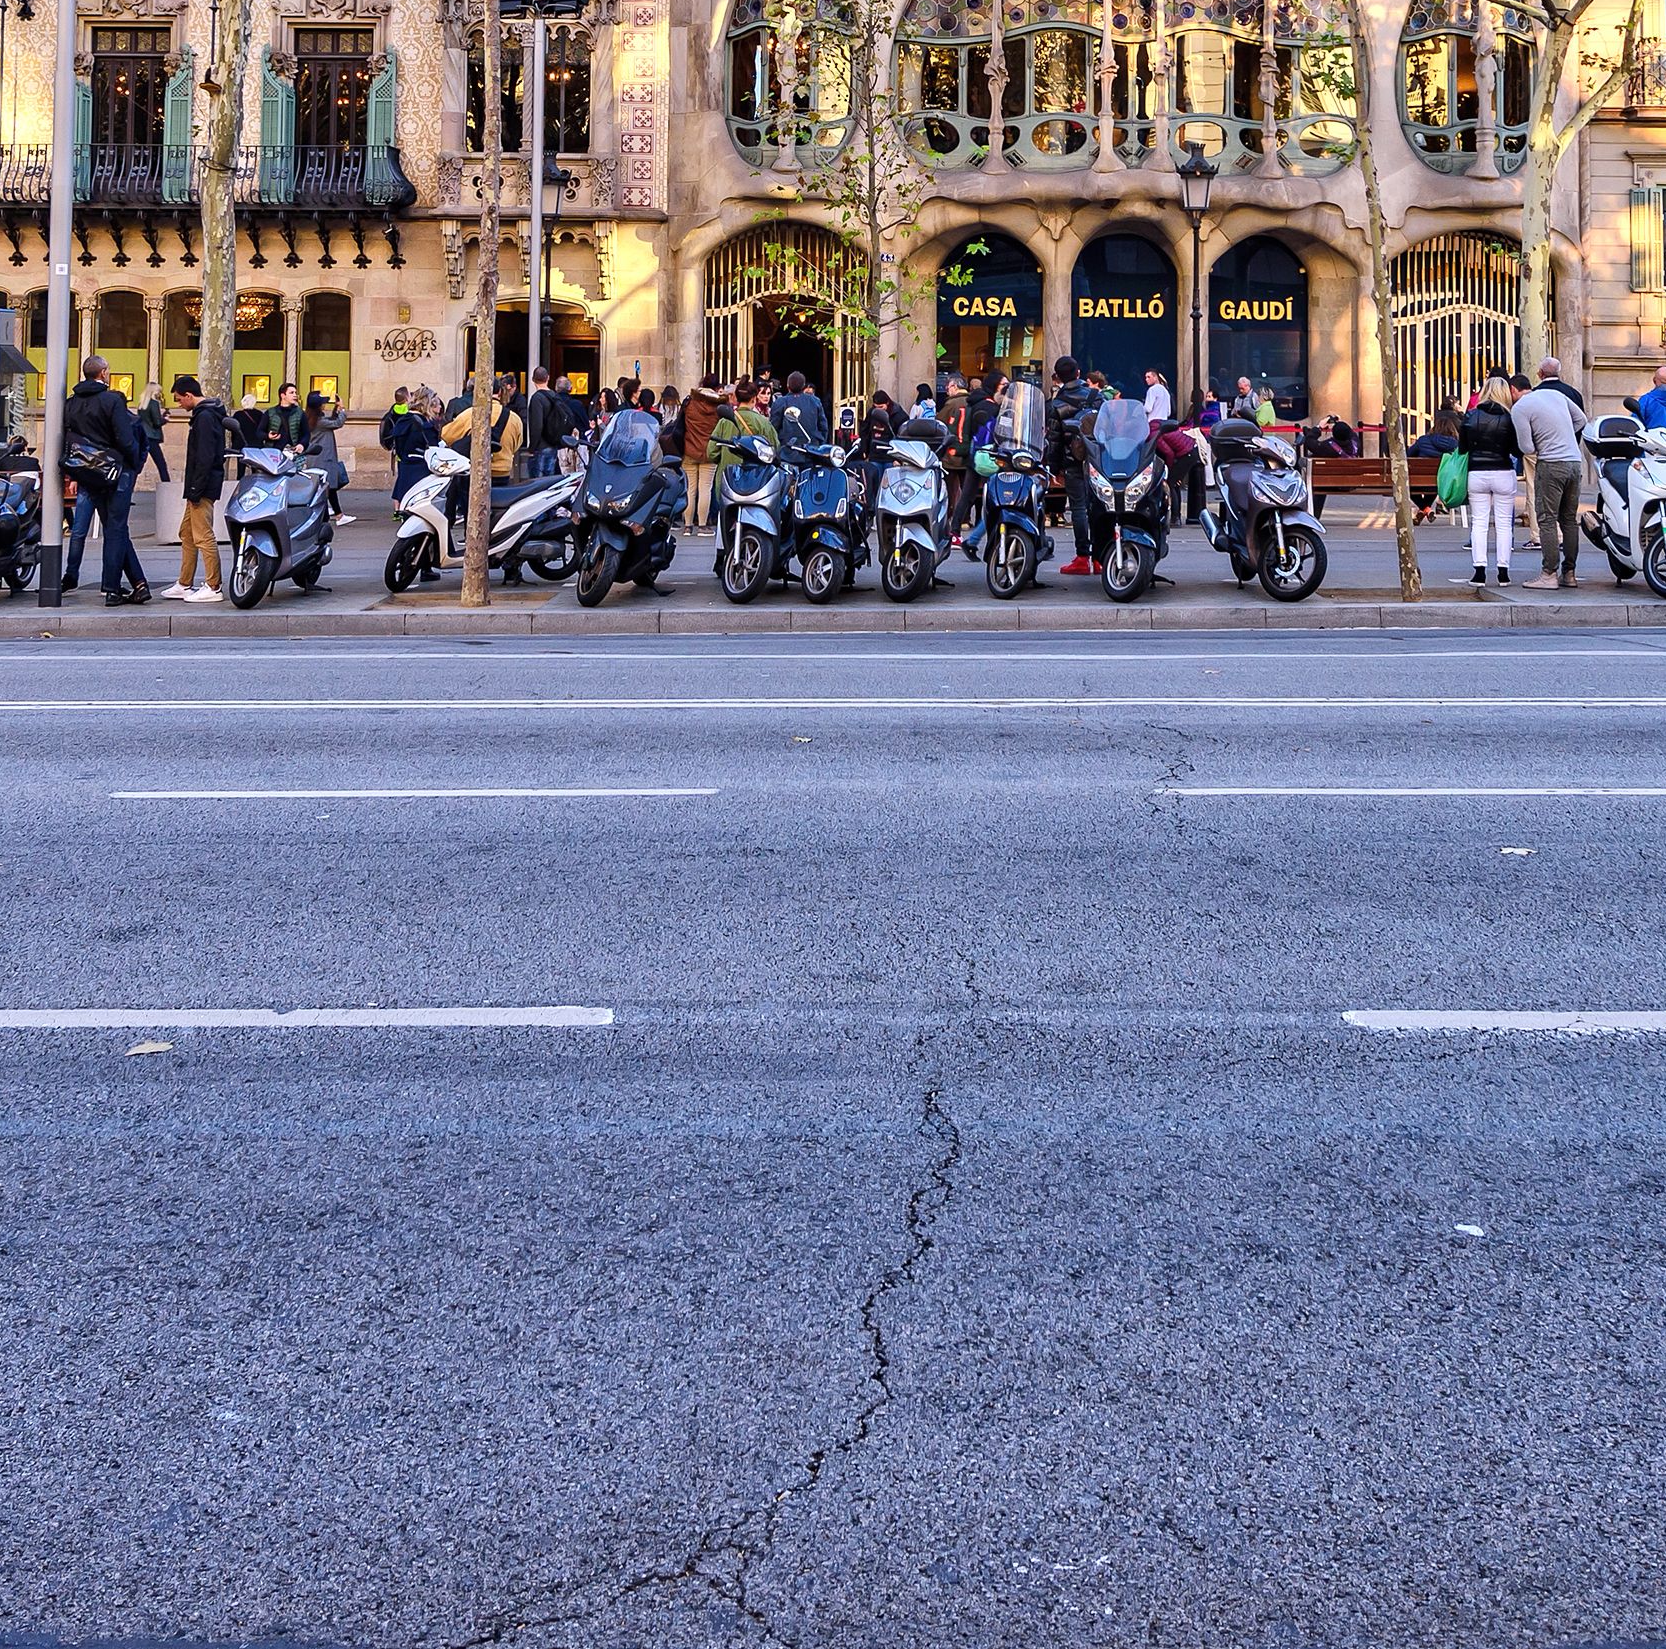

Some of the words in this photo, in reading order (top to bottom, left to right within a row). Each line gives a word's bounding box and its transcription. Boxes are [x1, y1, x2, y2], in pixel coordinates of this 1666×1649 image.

[953, 296, 1018, 317] CASA
[1078, 292, 1165, 319] BATLLÓ
[1219, 296, 1294, 321] GAUDÍ
